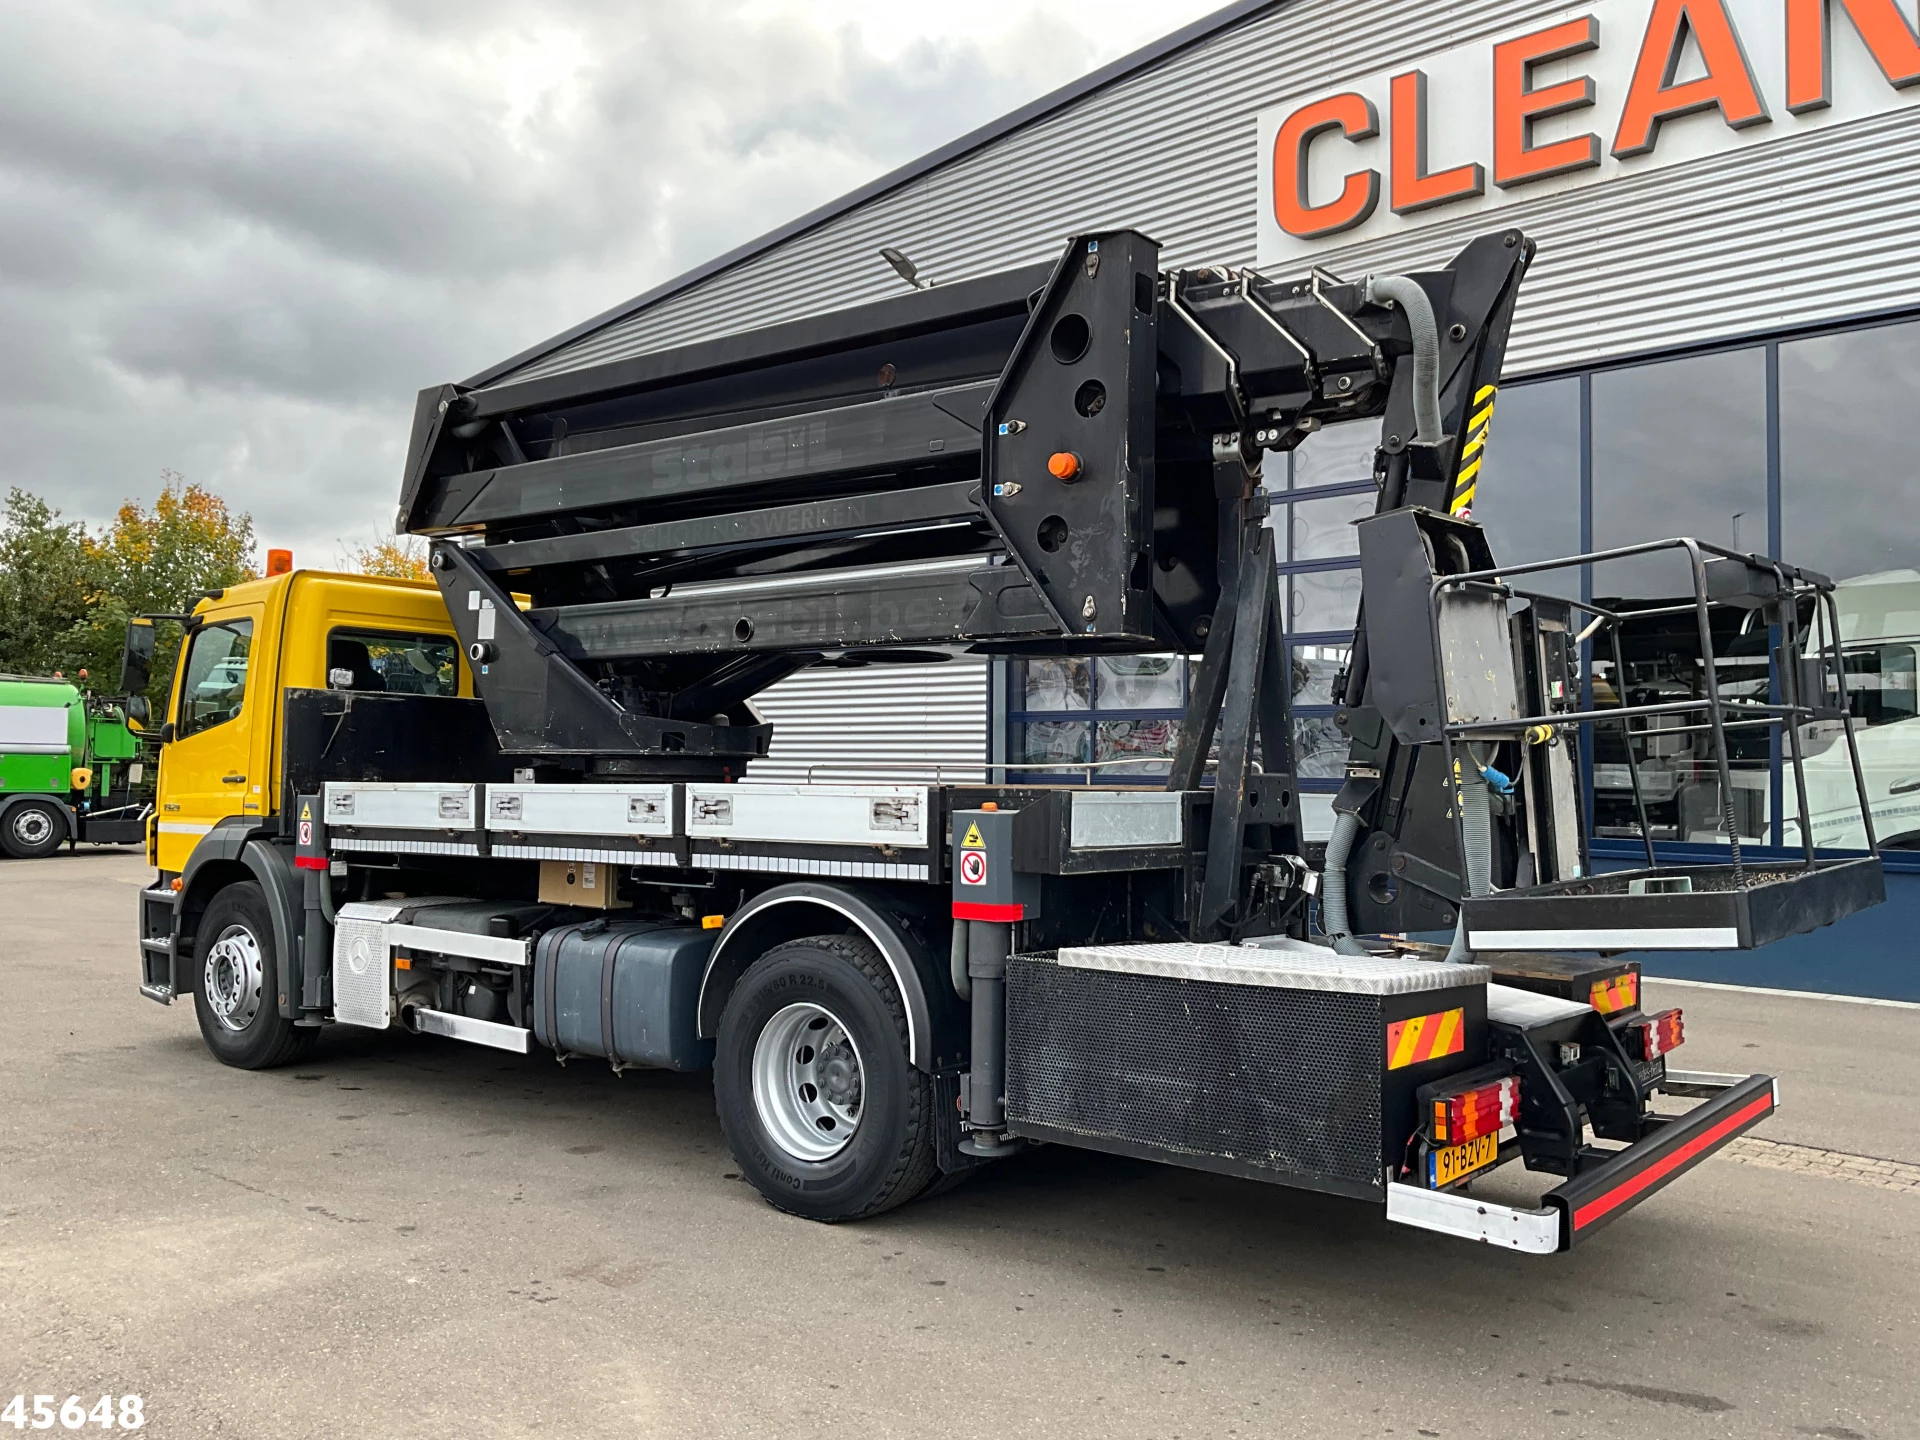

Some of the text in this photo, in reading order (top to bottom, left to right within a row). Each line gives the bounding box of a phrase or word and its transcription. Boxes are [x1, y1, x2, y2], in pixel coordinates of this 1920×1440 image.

[1273, 0, 1920, 240] CLEAN
[799, 974, 825, 990] 22.5
[1442, 1134, 1492, 1179] 91-BZV-7
